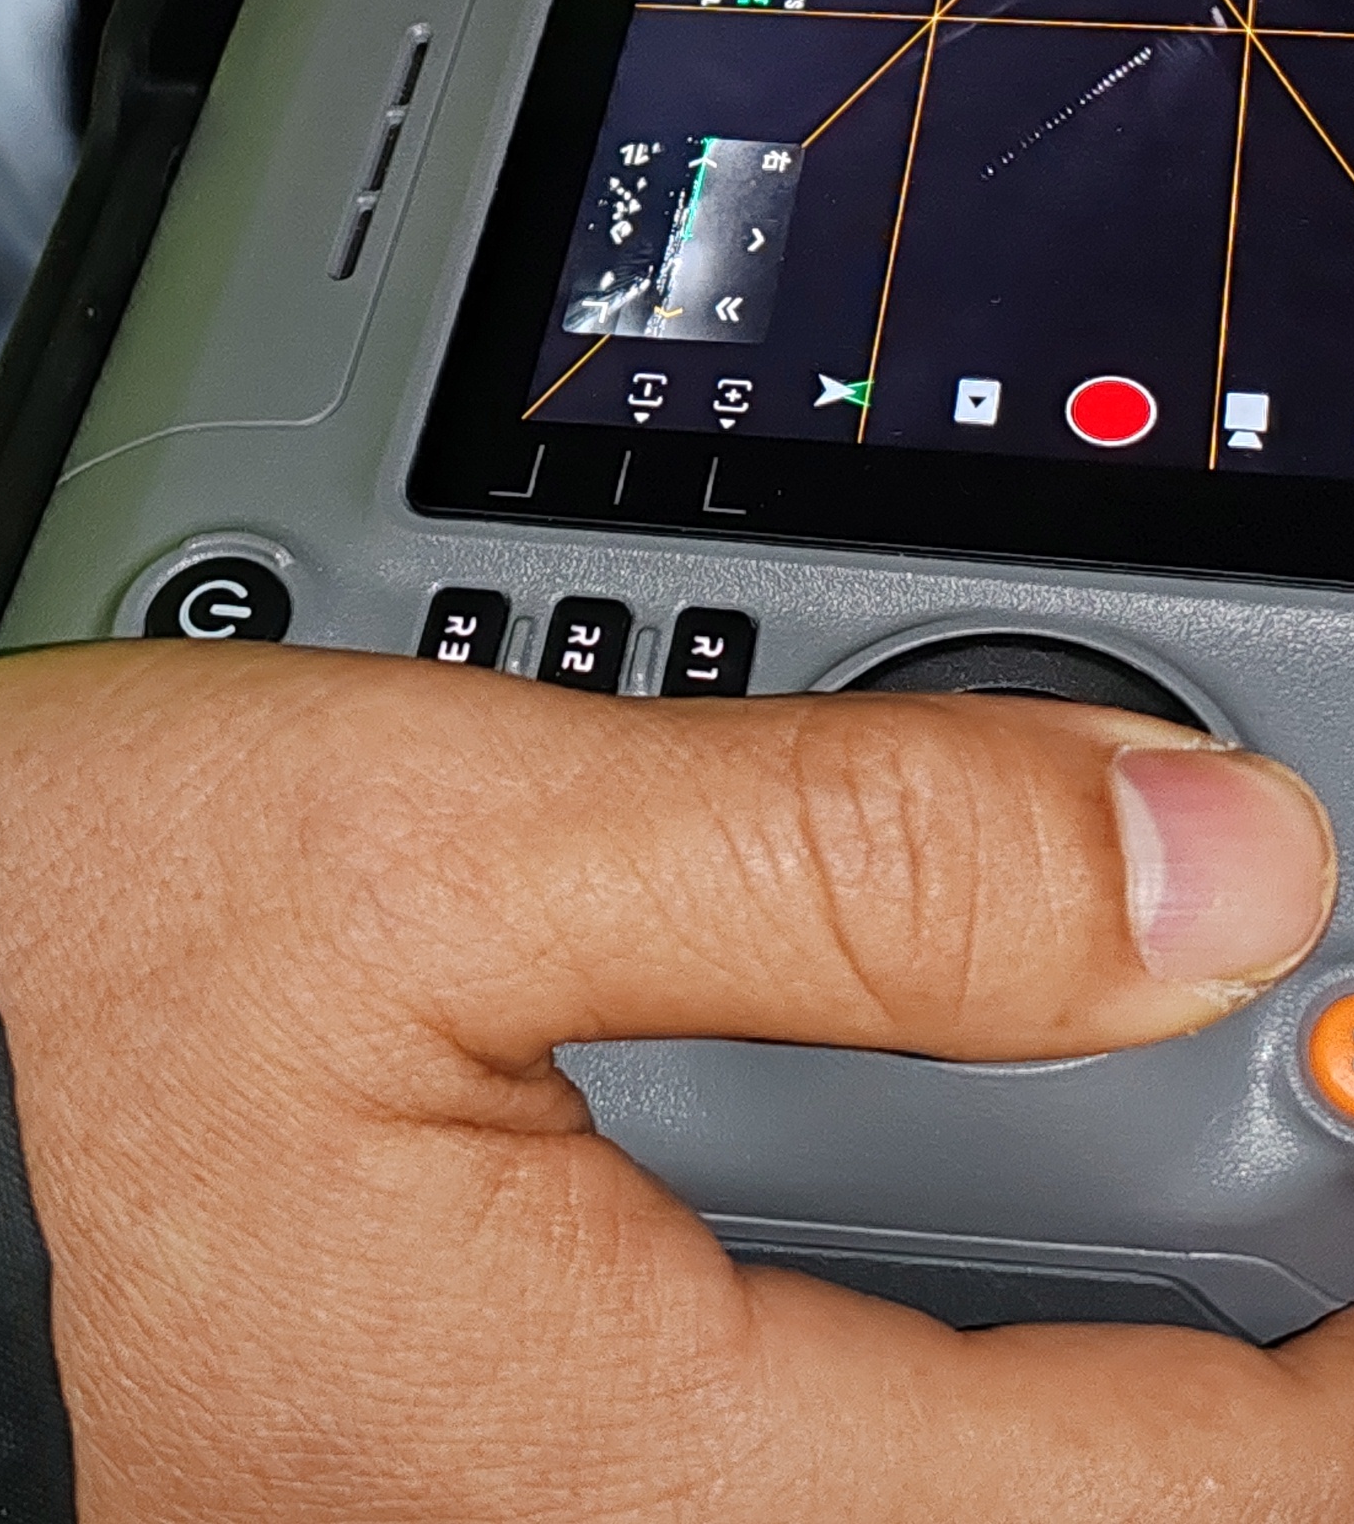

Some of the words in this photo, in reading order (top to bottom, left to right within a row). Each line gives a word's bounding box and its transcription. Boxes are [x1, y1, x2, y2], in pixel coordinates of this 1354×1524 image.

[762, 150, 791, 172] 右
[437, 616, 477, 662] R3
[561, 624, 601, 672] R2
[687, 636, 724, 680] R1
